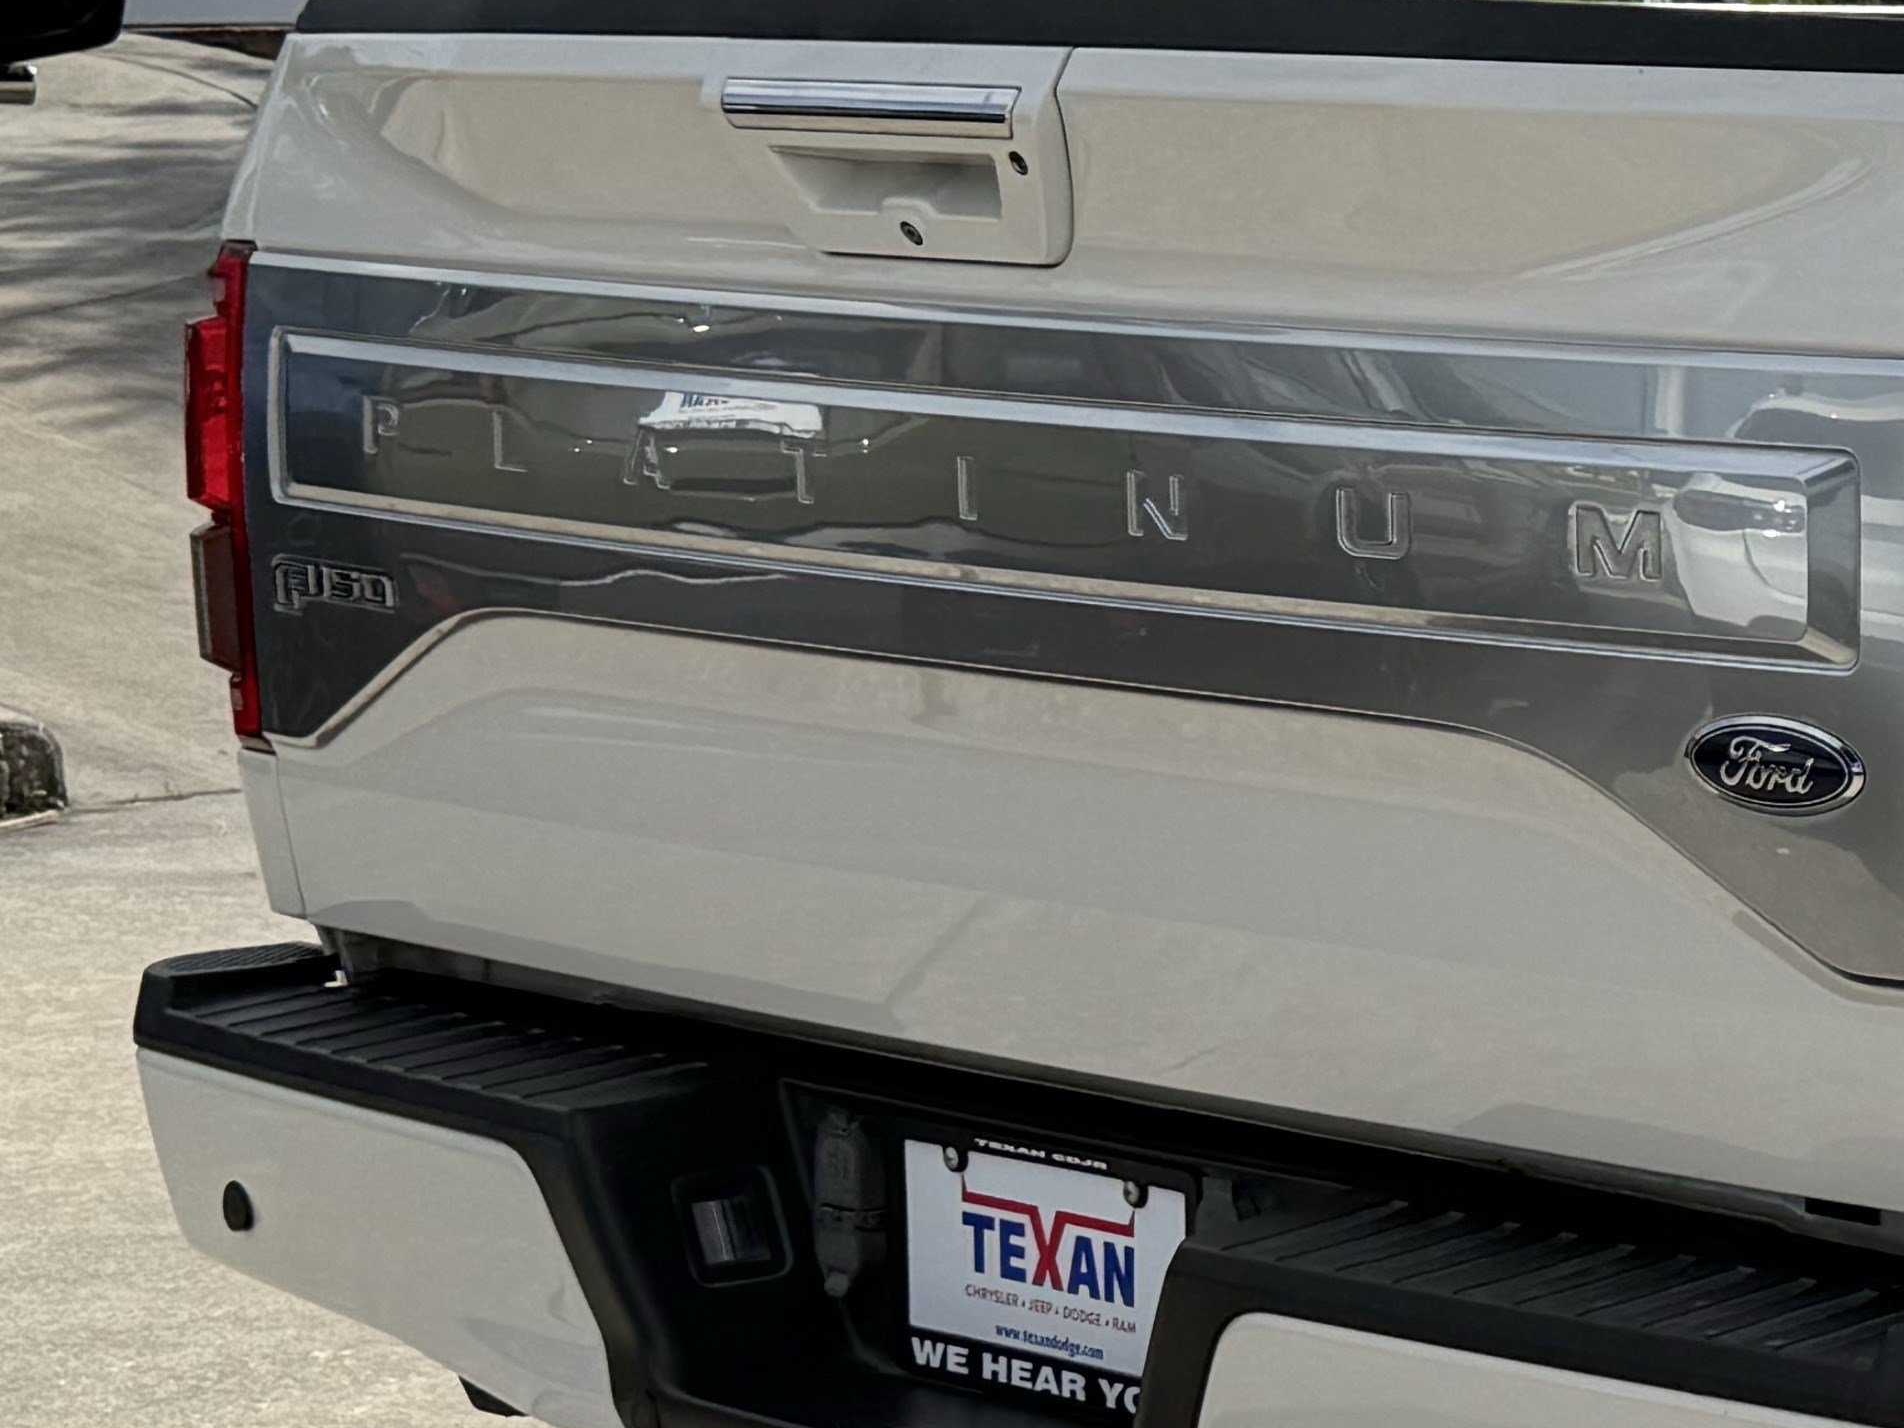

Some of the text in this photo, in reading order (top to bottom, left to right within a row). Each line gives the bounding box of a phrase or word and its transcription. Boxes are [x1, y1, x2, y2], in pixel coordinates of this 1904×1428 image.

[1720, 735, 1815, 794] Ford
[962, 1203, 1135, 1308] TEXAN
[965, 1283, 1137, 1334] CHRYSLER JEEP DODGE RAM
[911, 1335, 1142, 1415] WE HEAR YO
